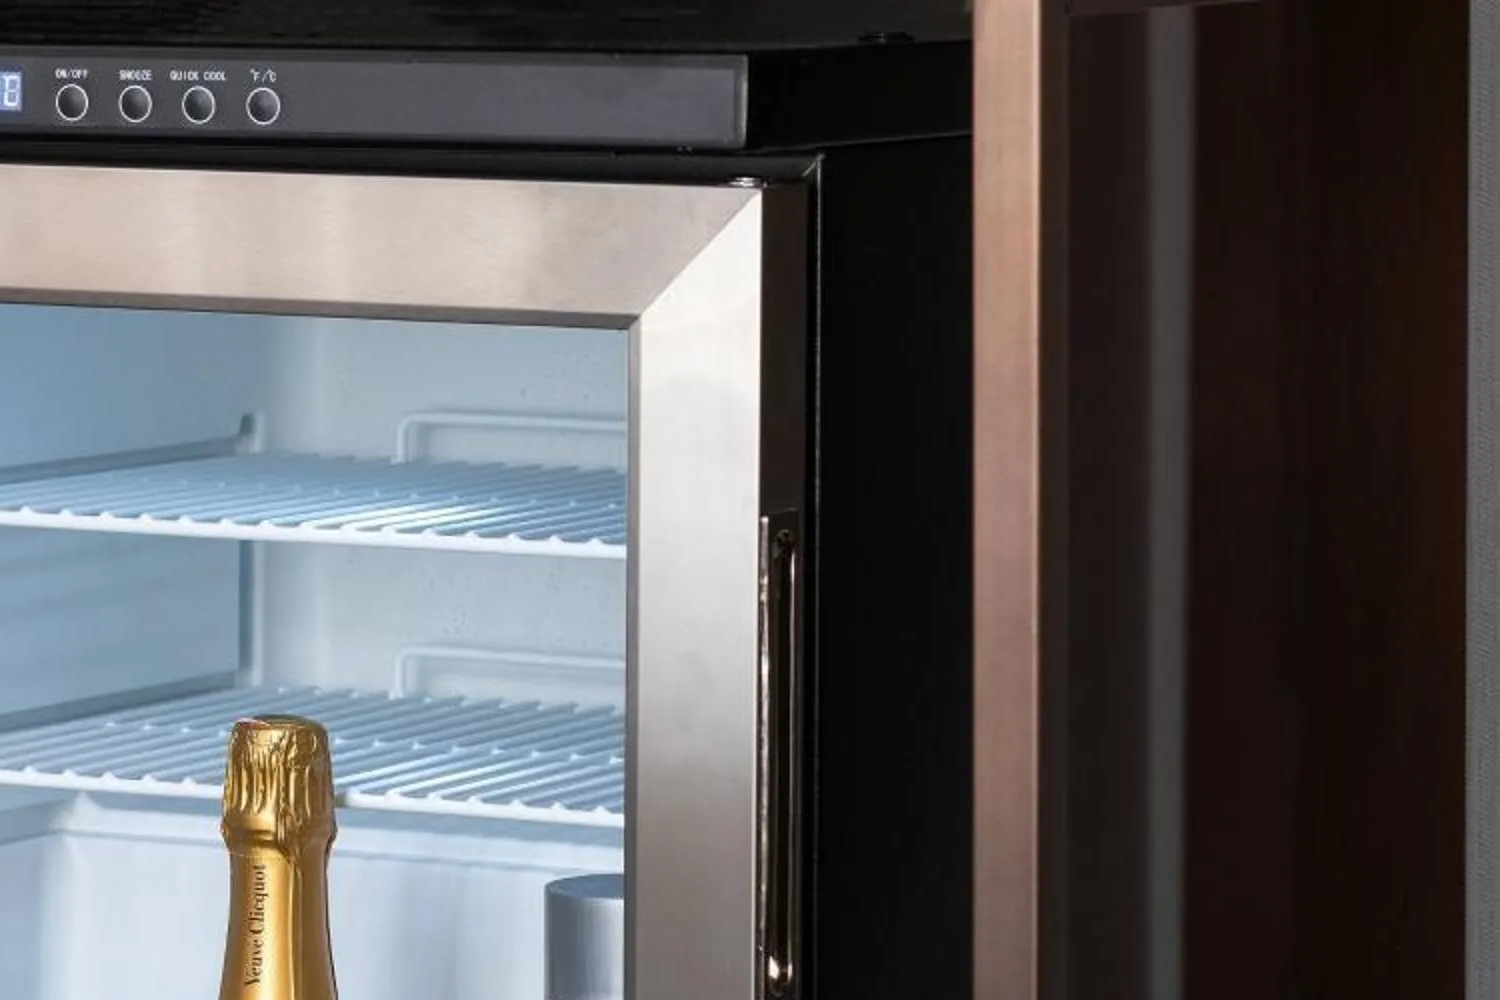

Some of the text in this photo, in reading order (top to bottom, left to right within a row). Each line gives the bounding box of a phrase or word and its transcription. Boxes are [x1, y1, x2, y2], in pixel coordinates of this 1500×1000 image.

[55, 68, 88, 79] ON/OFF
[119, 69, 152, 81] SNOOZE
[169, 70, 227, 81] QUICK COOL
[243, 864, 269, 987] Veuve Clicquot
